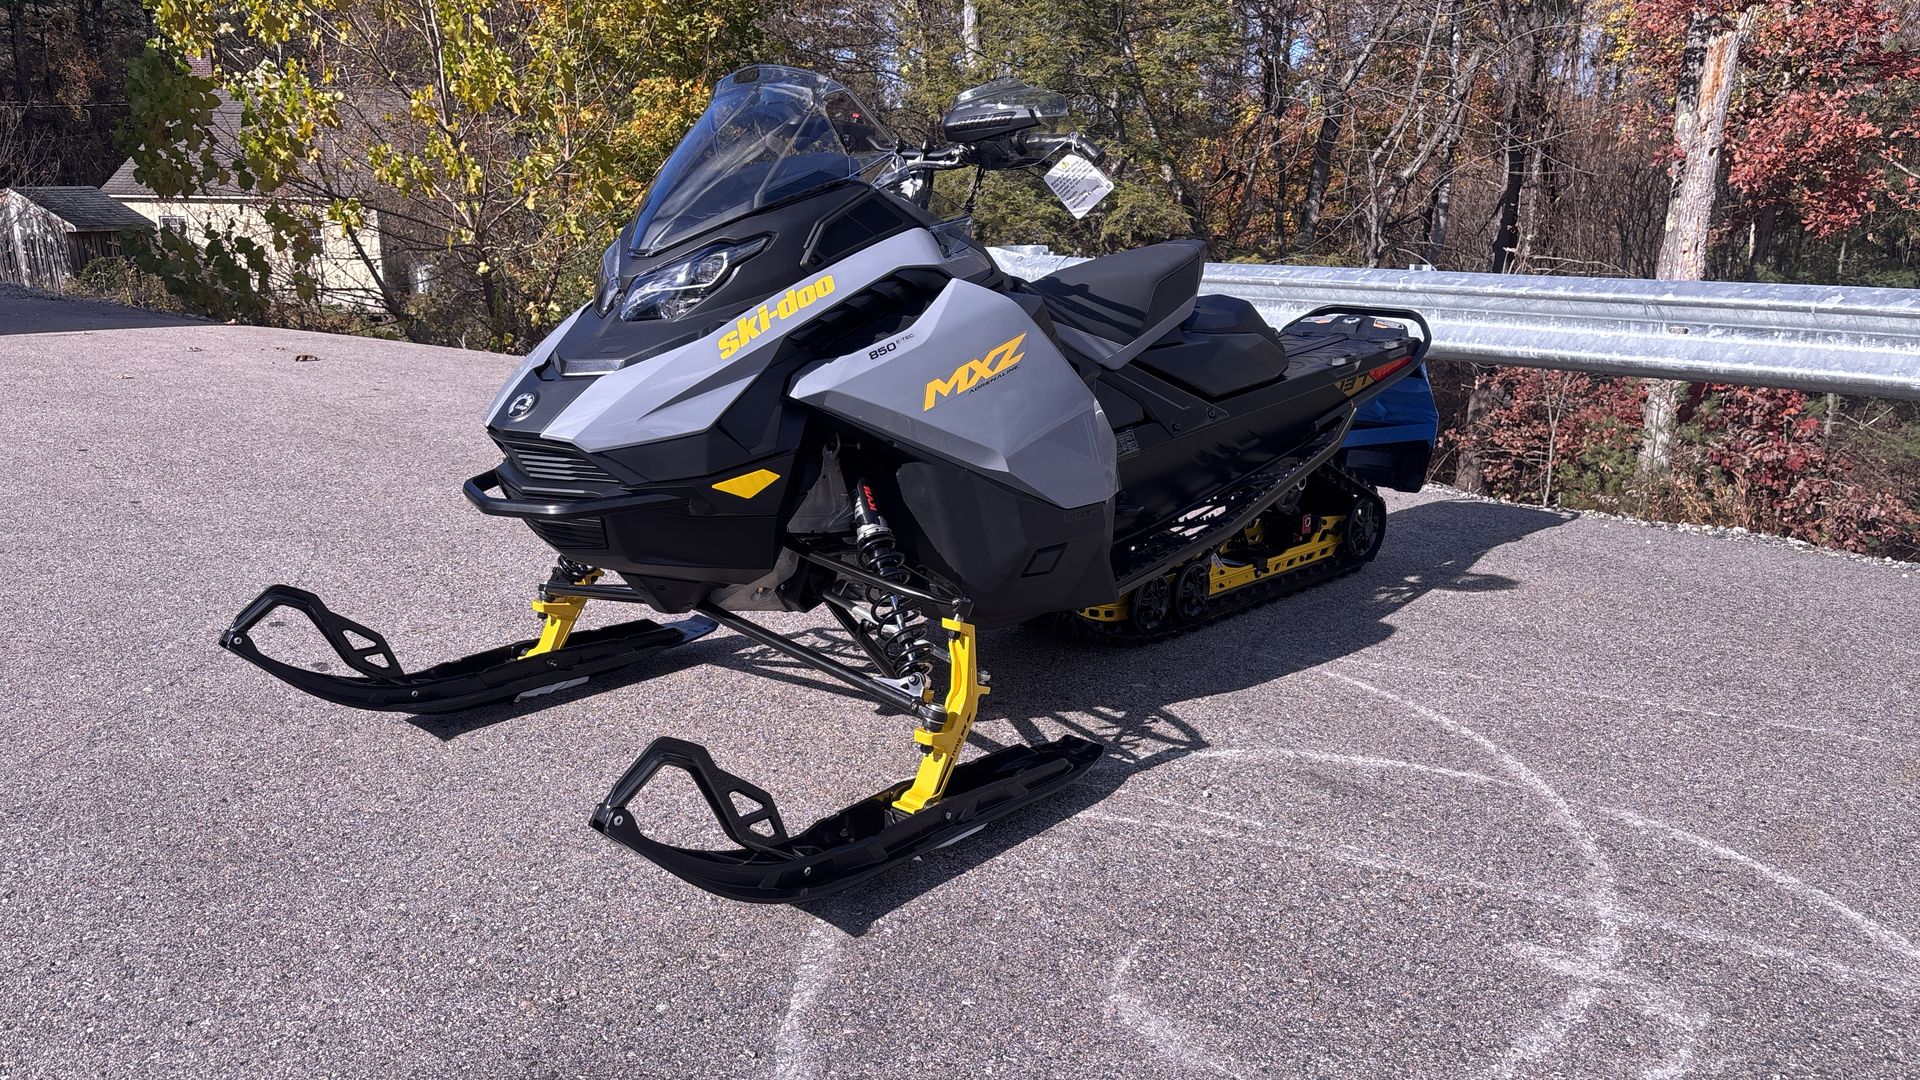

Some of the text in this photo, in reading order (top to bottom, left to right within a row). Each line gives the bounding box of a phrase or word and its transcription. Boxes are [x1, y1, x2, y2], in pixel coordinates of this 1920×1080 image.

[718, 274, 836, 360] ski-doo
[869, 342, 896, 360] 850
[924, 332, 1027, 412] MXZ
[968, 365, 1019, 395] ADRENALINE
